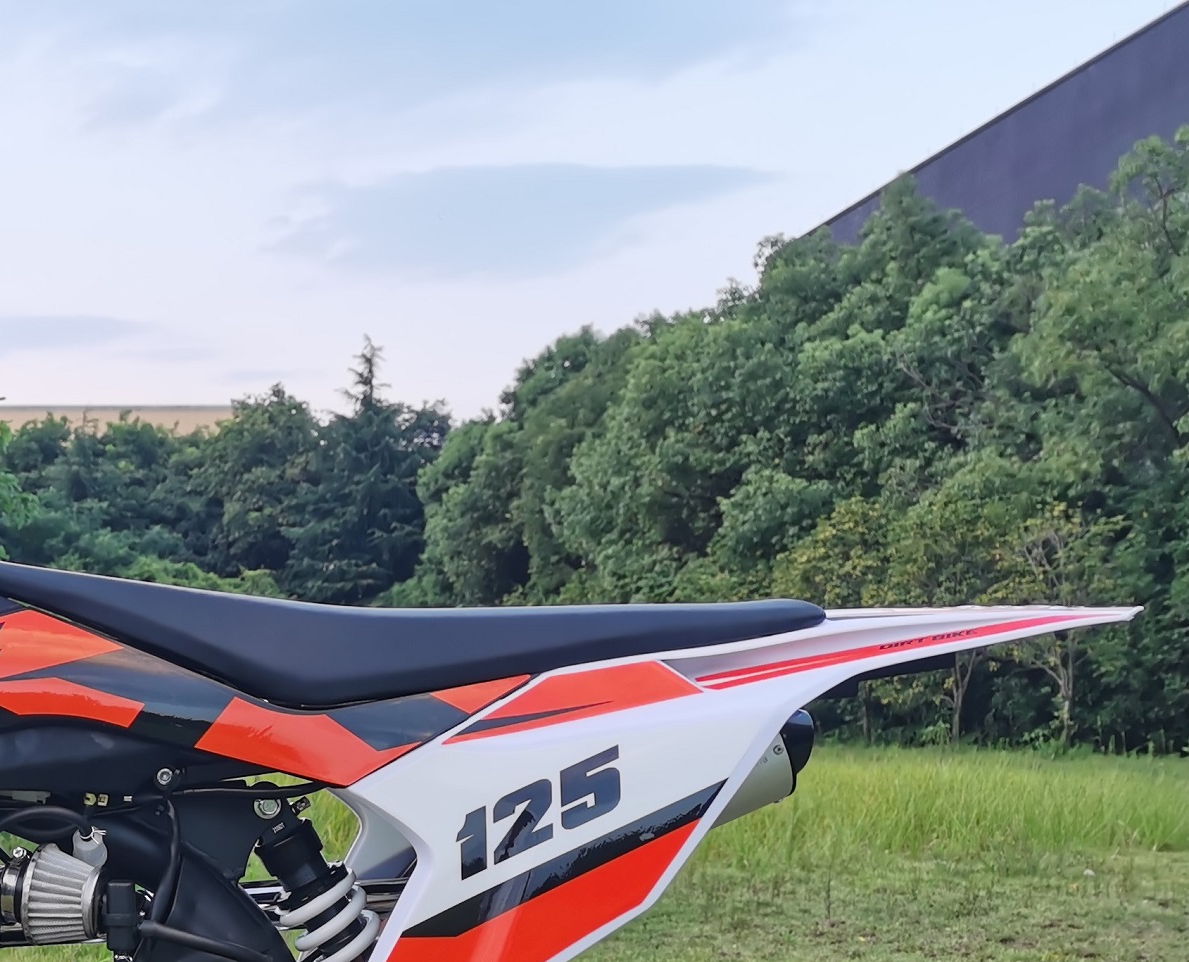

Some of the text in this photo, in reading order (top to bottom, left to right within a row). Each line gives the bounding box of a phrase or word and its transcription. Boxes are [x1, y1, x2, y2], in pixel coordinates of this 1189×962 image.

[879, 628, 979, 650] DIRT BIKE
[455, 745, 621, 881] 125
